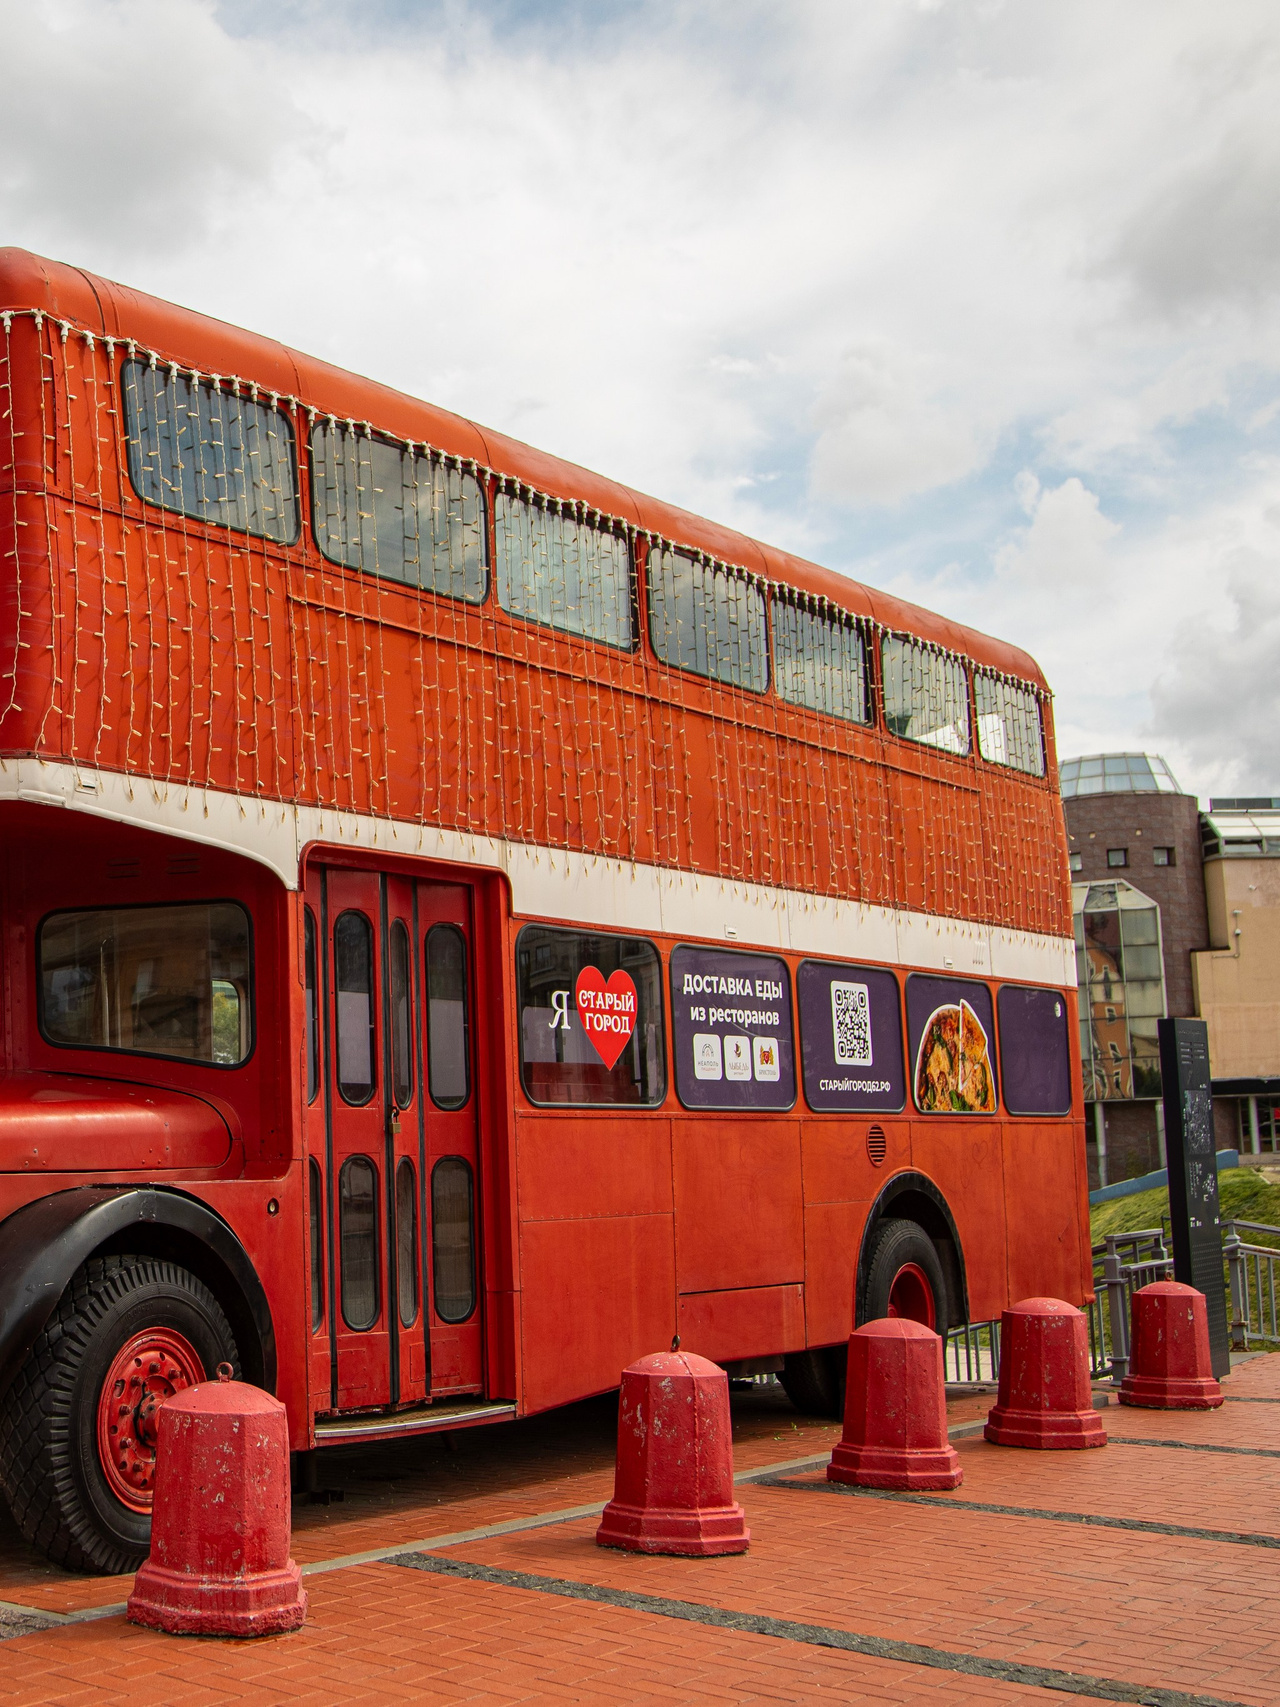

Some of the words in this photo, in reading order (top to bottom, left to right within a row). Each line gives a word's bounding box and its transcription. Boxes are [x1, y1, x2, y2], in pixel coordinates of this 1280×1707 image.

[683, 973, 753, 997] ДОСТАВКА
[755, 979, 783, 1001] ЕДЫ
[548, 990, 572, 1030] Я
[578, 989, 634, 1012] СТАРЫЙ
[585, 1012, 631, 1034] ГОРОД
[690, 1006, 706, 1021] из
[709, 1007, 780, 1028] ресторанов
[819, 1077, 892, 1094] СТАРЫЙГОРОД62.РФ
